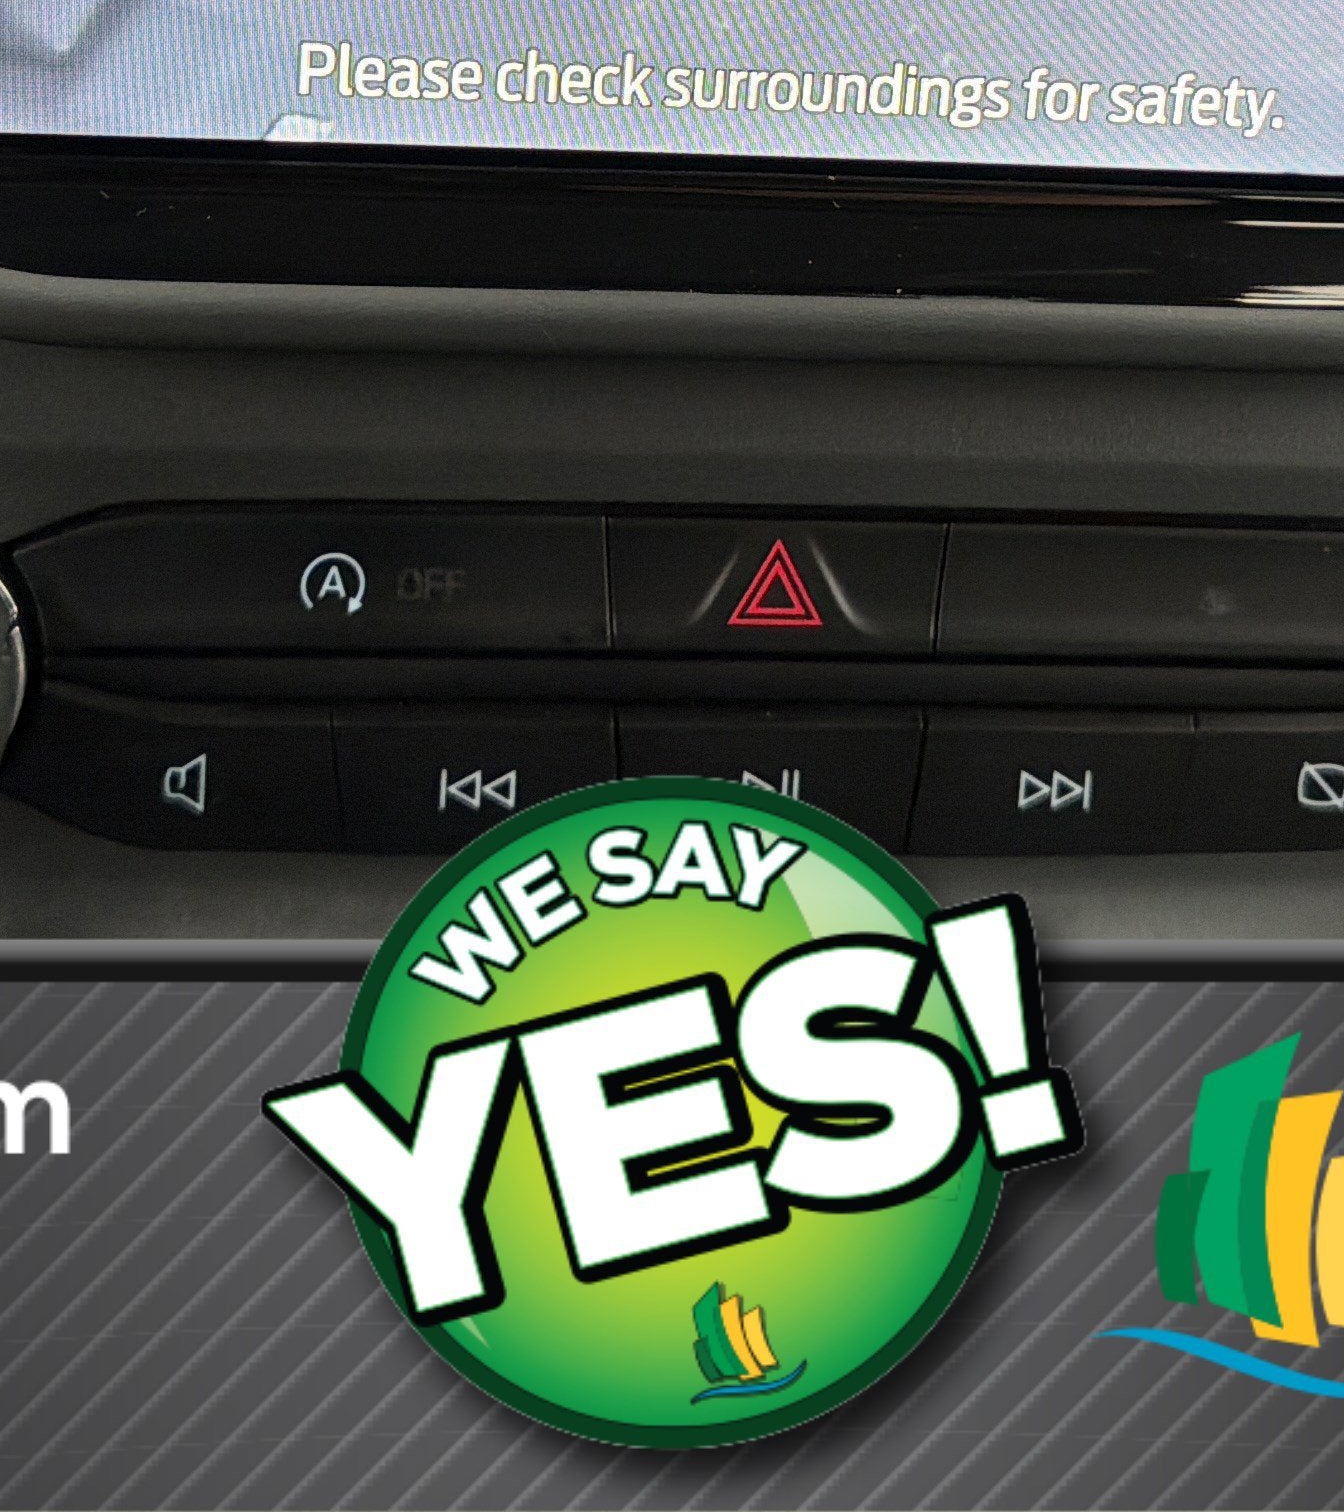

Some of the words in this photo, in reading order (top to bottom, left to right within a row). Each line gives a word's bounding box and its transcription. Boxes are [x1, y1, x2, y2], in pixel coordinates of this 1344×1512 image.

[296, 39, 484, 102] Please
[495, 47, 654, 108] check
[663, 61, 1010, 129] surroundings
[1022, 66, 1101, 124] for
[1106, 71, 1287, 138] safety.
